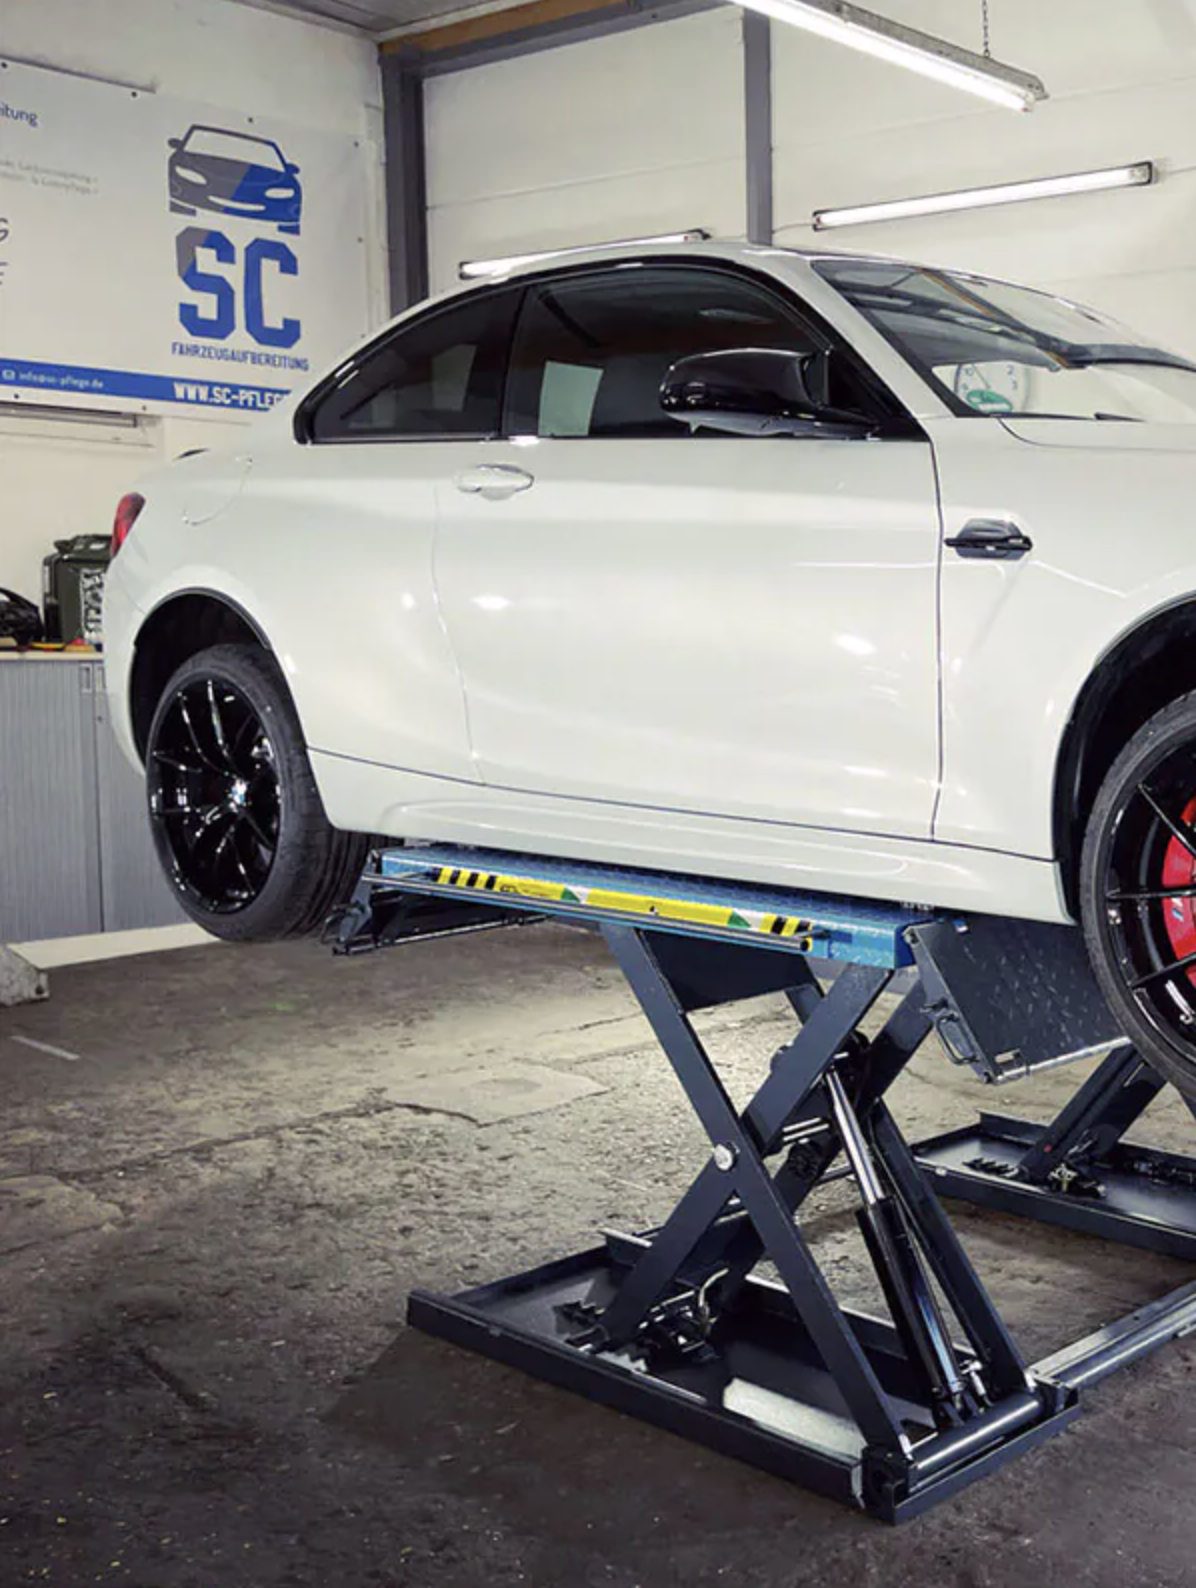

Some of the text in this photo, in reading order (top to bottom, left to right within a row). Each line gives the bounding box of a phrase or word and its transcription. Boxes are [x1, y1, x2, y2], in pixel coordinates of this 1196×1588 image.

[0, 101, 38, 128] itung
[176, 226, 301, 349] SC
[171, 341, 309, 371] FAHRZEUGAUFBEREITUNG
